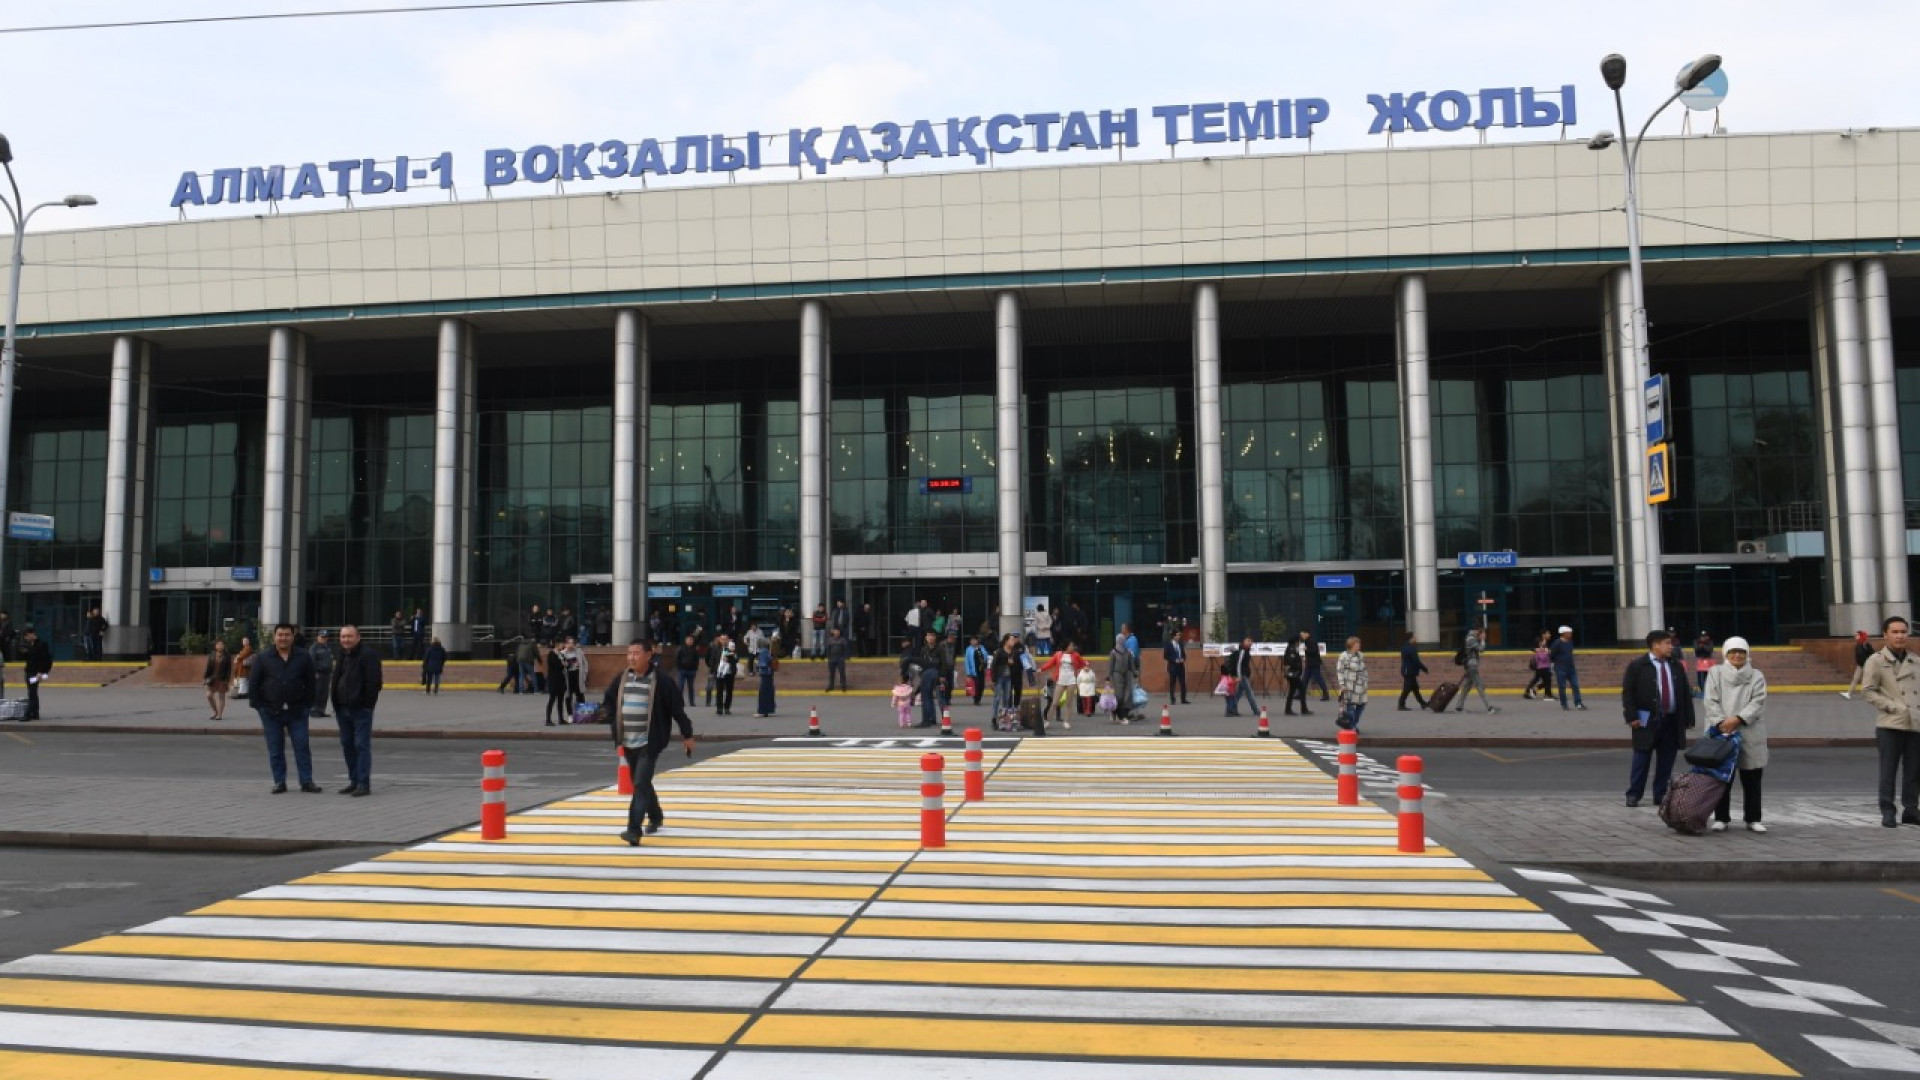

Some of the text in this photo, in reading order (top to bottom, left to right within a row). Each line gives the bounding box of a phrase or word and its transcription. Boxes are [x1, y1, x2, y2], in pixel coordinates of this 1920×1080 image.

[171, 84, 1577, 207] АЛМАТЫ-1 ВОКЗАЛЫ ҚАЗАҚСТАН ТЕМІР ЖОЛЫ
[1478, 554, 1512, 565] iFood
